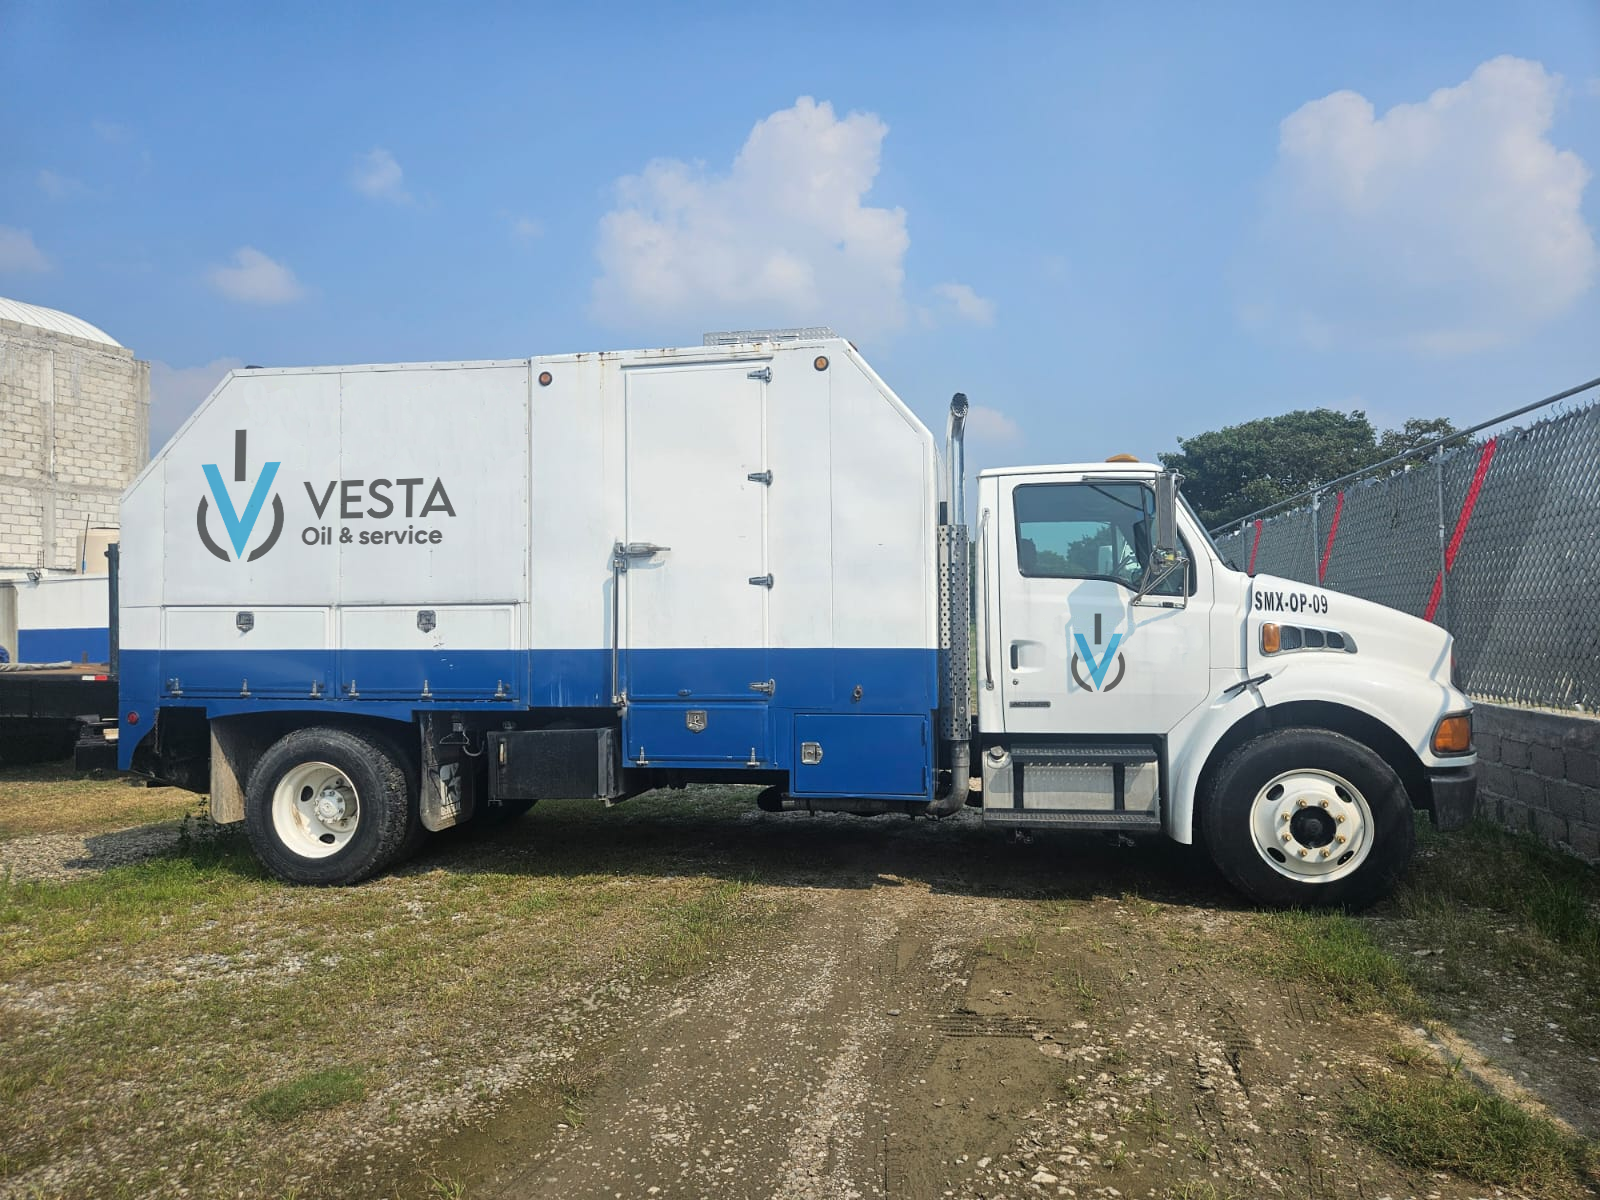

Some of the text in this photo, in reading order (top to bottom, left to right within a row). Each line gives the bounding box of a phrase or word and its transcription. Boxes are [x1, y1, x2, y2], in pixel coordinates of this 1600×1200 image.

[303, 476, 457, 521] VESTA
[301, 525, 443, 546] Oil & service
[1254, 590, 1329, 614] SMX-OP-09
